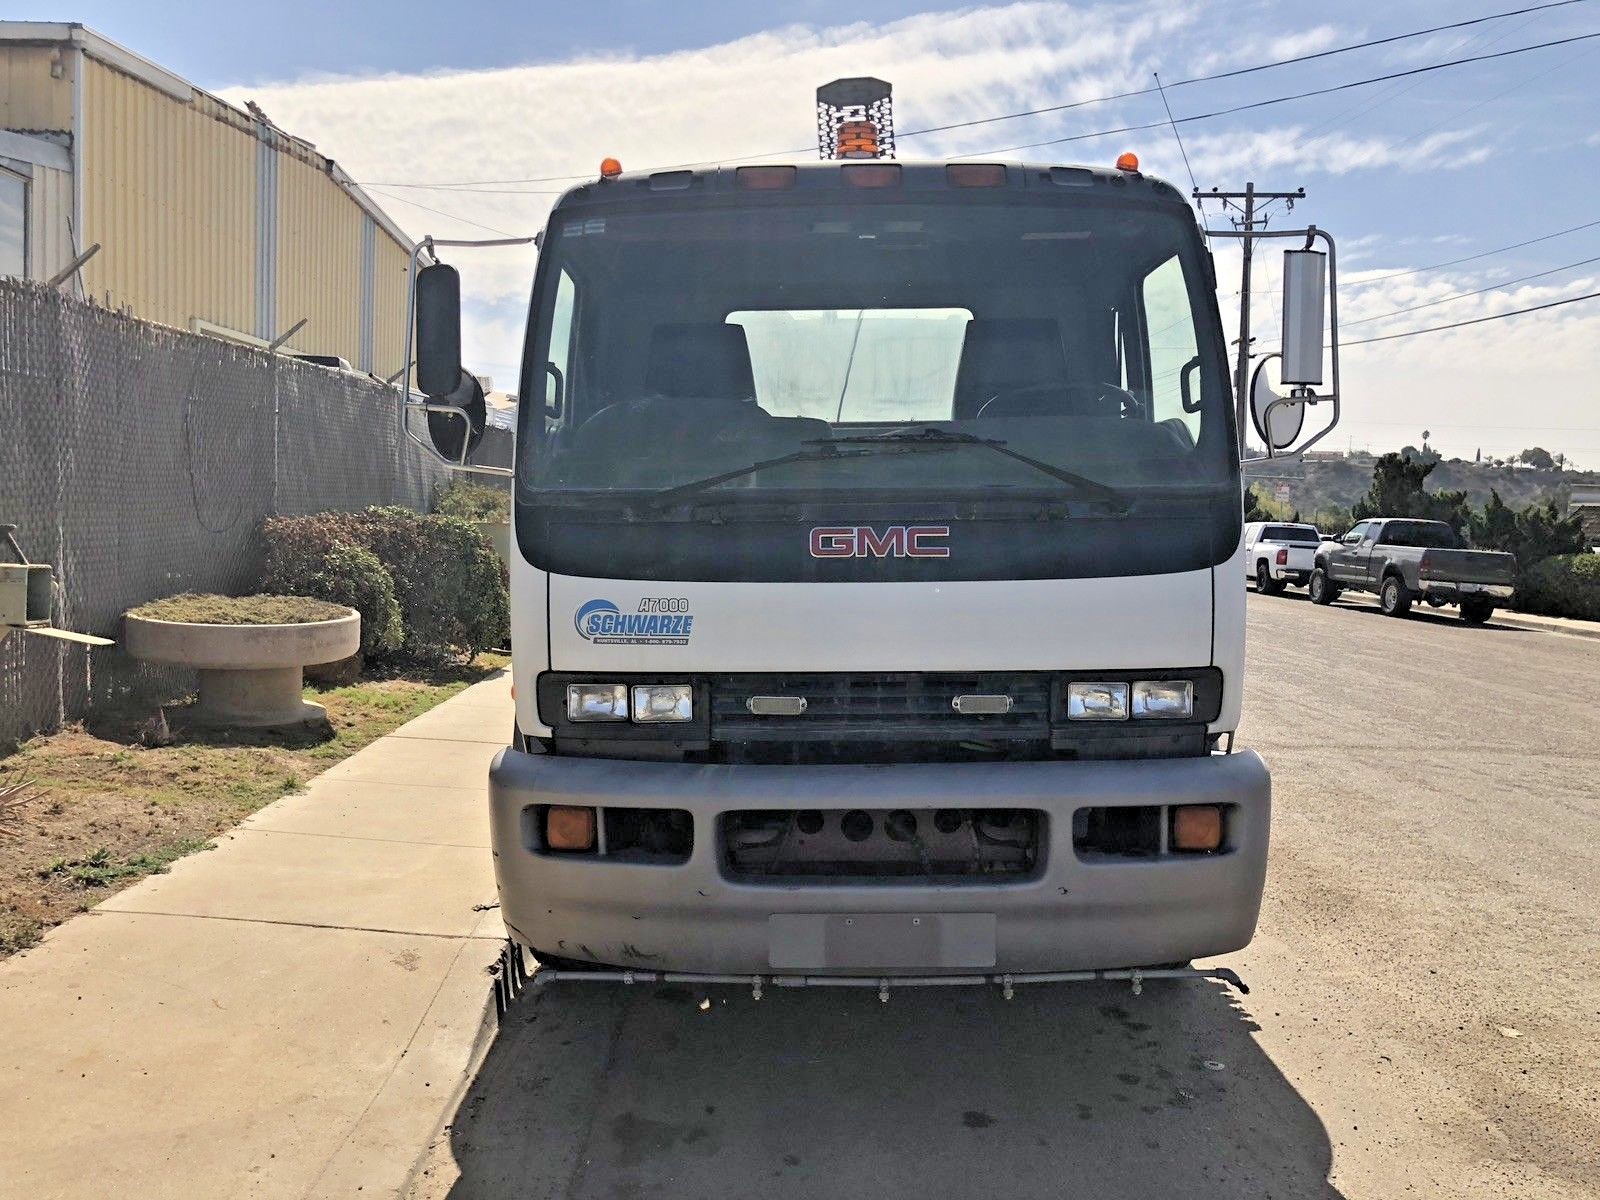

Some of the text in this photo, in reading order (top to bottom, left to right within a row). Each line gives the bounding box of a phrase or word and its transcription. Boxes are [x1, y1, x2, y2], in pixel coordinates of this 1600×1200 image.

[810, 526, 950, 558] GMC
[638, 597, 689, 613] A7000
[588, 614, 694, 636] SCHWARZE
